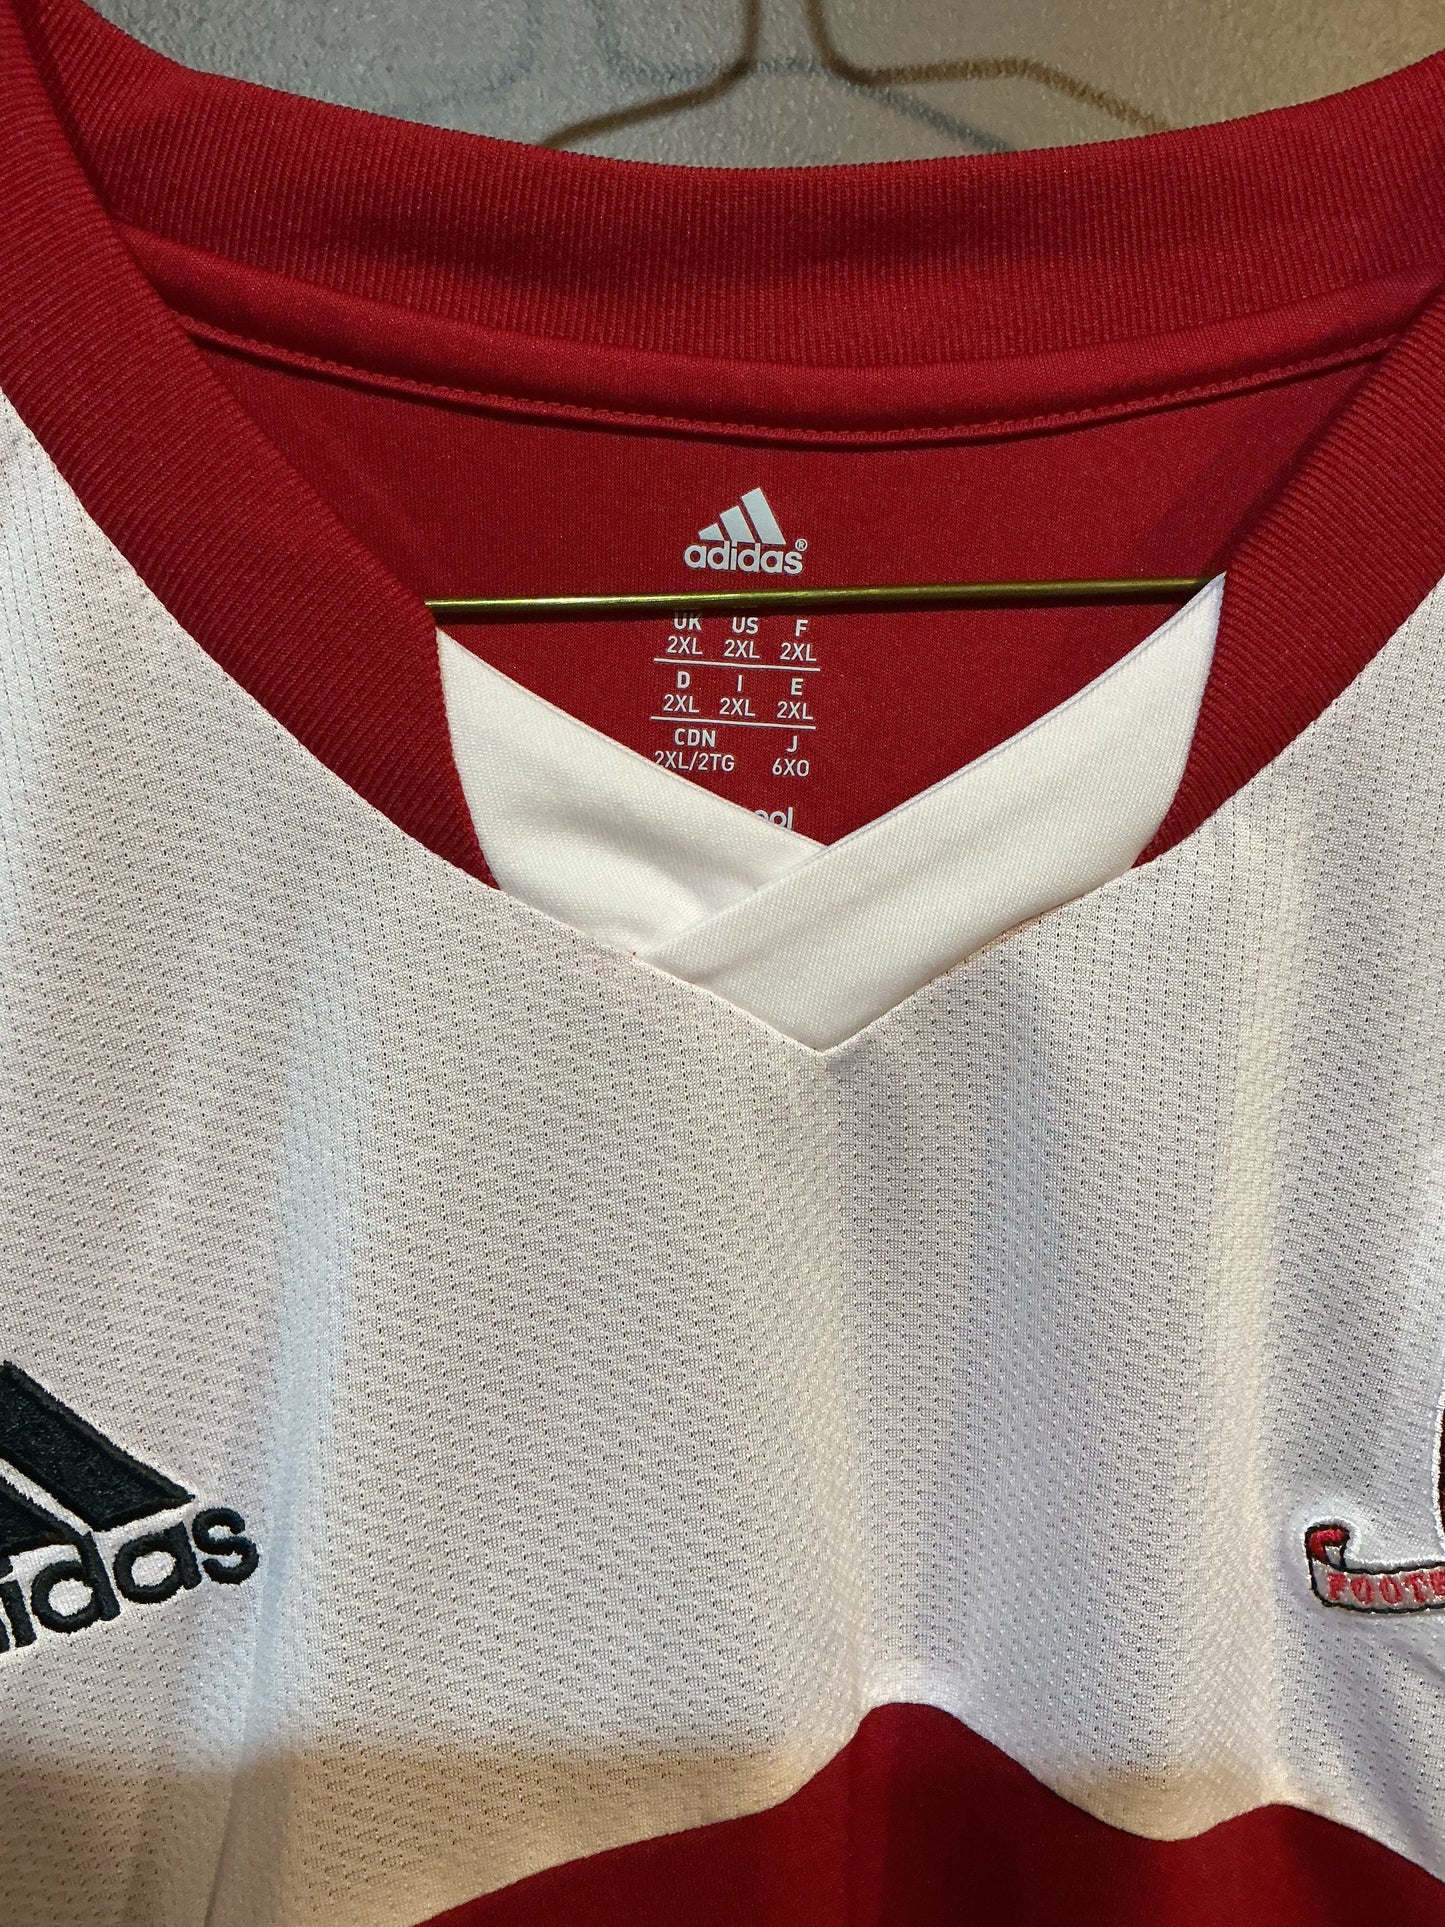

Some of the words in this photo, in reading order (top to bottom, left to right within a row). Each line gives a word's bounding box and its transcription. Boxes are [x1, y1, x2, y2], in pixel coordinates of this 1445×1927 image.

[673, 612, 702, 631] UK
[731, 616, 759, 634] US
[795, 619, 809, 637] F
[666, 635, 703, 655] 2XL
[723, 639, 760, 659] 2XL
[779, 642, 817, 662] 2XL
[676, 671, 691, 689] D
[790, 678, 804, 696] E
[662, 694, 700, 713] 2XL
[719, 698, 756, 717] 2XL
[776, 702, 814, 721] 2XL
[674, 728, 716, 747] CDN
[786, 735, 798, 753] J
[654, 750, 735, 772] 2XL/2TG
